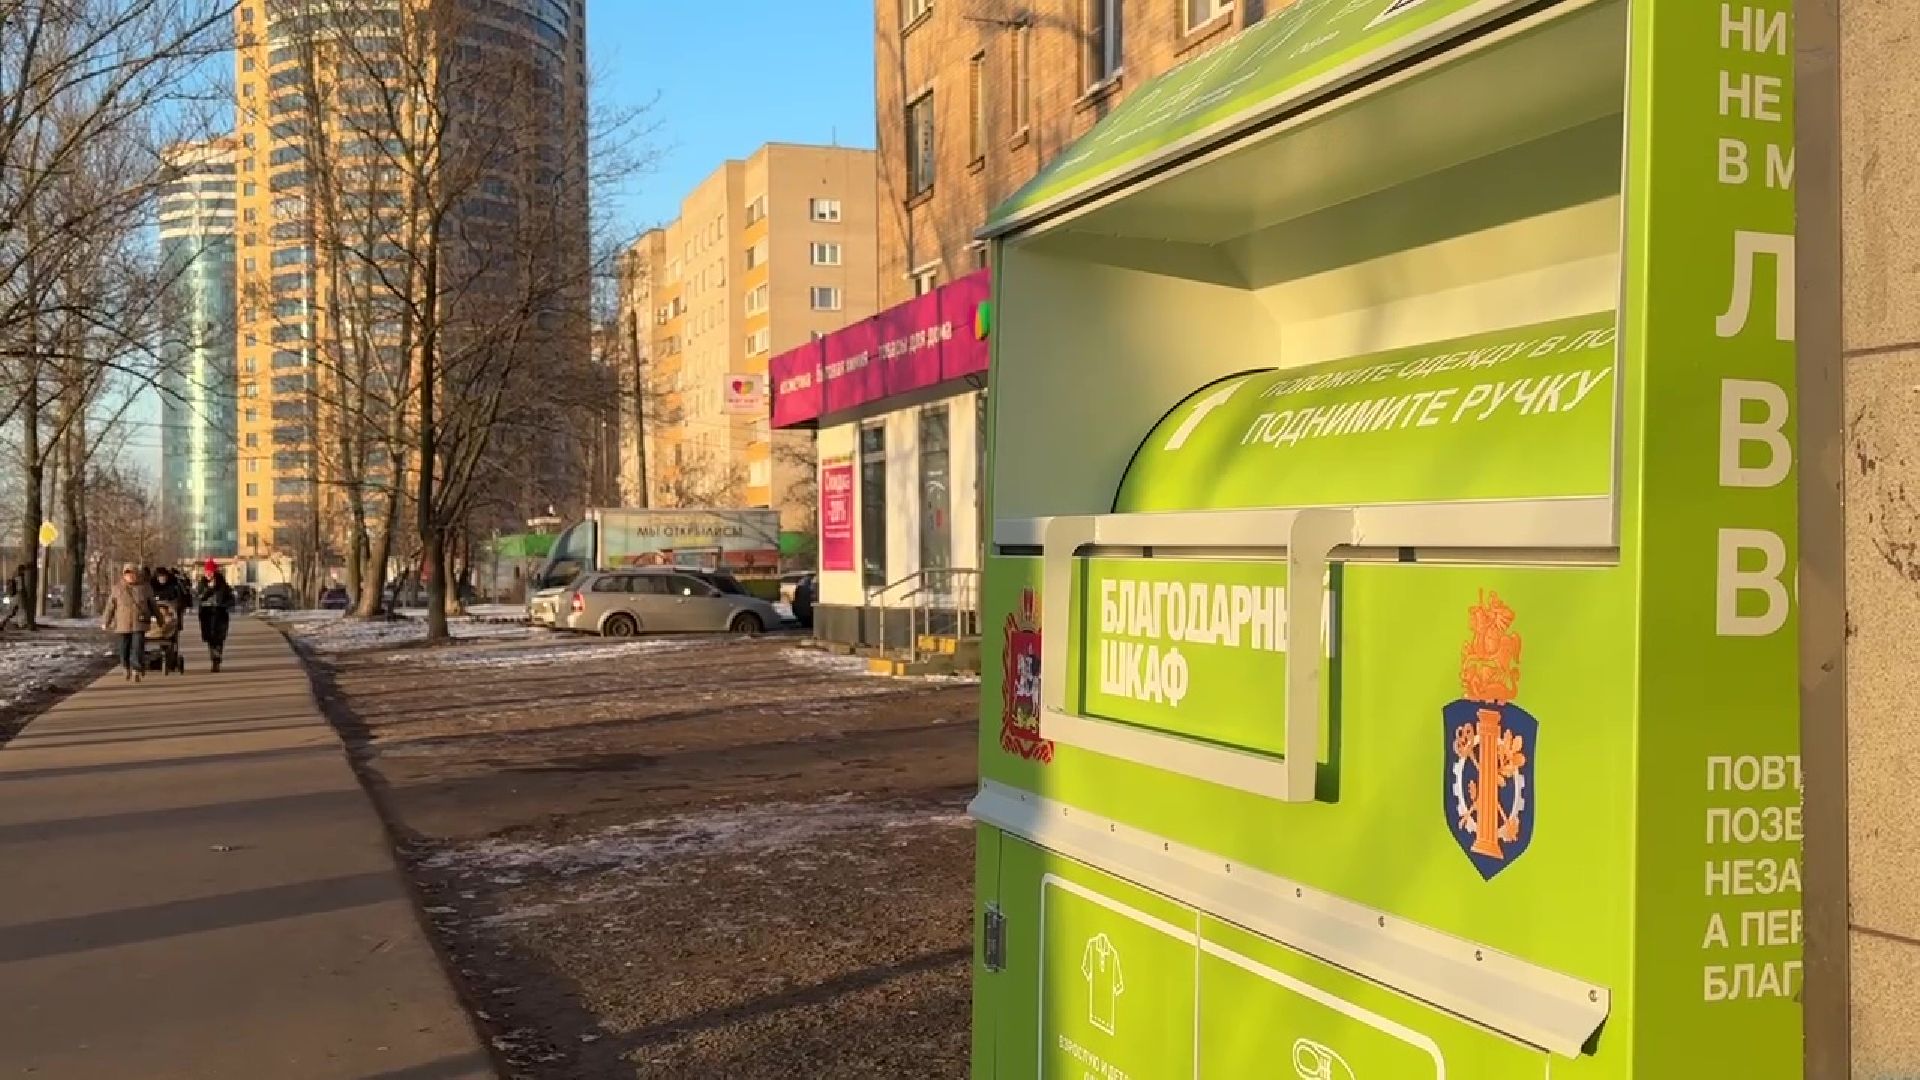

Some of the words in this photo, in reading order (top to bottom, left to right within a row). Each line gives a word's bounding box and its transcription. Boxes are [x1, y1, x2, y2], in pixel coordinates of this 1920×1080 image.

[1721, 3, 1786, 55] НИ
[1719, 70, 1782, 121] НЕ
[1718, 138, 1748, 184] В
[1260, 361, 1402, 397] ПОЛОЖИТЕ
[1397, 339, 1539, 379] ОДЕЖДУ
[1527, 336, 1567, 358] В
[1240, 387, 1459, 448] ПОДНИМИТЕ
[1451, 366, 1612, 424] РУЧКУ
[1719, 378, 1791, 487] В
[1716, 527, 1798, 636] В
[1101, 639, 1189, 707] ШКАФ
[1705, 858, 1802, 896] НЕЗА
[1702, 913, 1729, 949] А
